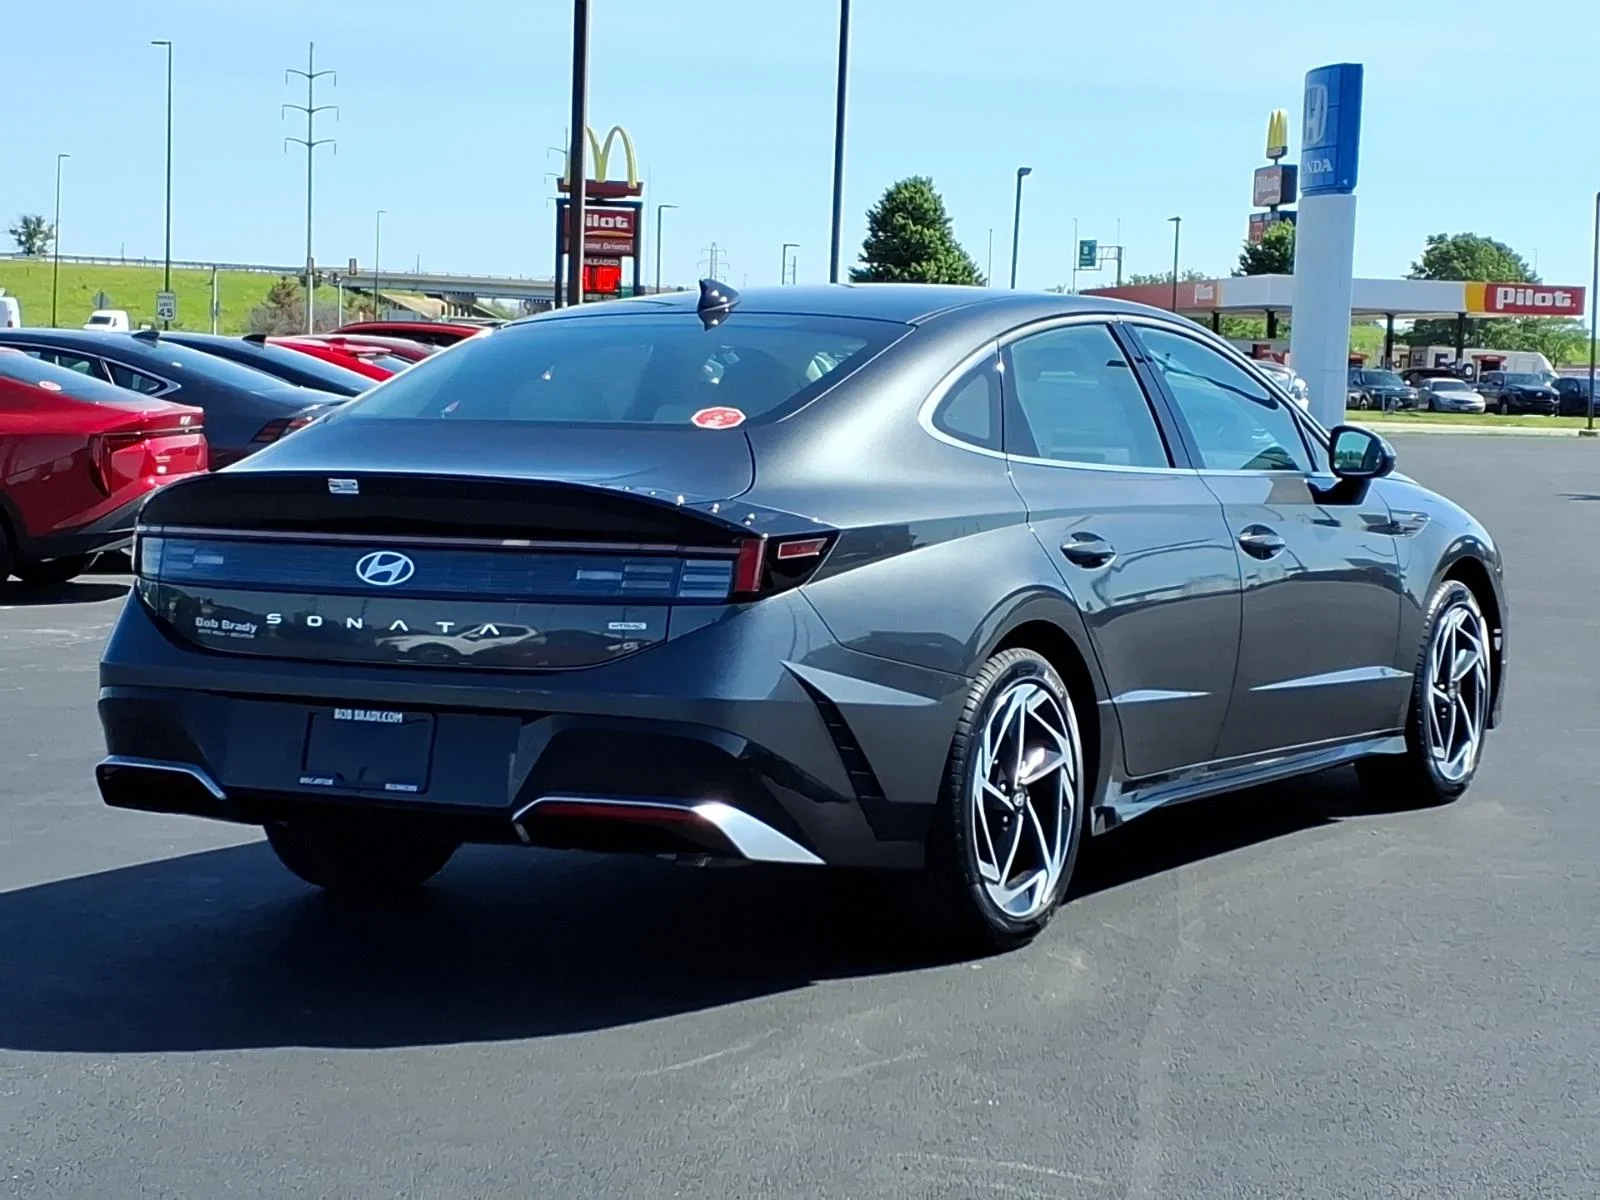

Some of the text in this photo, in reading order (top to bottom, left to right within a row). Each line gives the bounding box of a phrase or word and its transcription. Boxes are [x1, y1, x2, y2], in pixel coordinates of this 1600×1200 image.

[586, 214, 628, 228] ilot
[1496, 287, 1572, 310] Pilot
[158, 308, 173, 317] 45
[195, 617, 219, 629] Bob
[221, 619, 258, 634] Brady
[265, 612, 501, 636] SONATA
